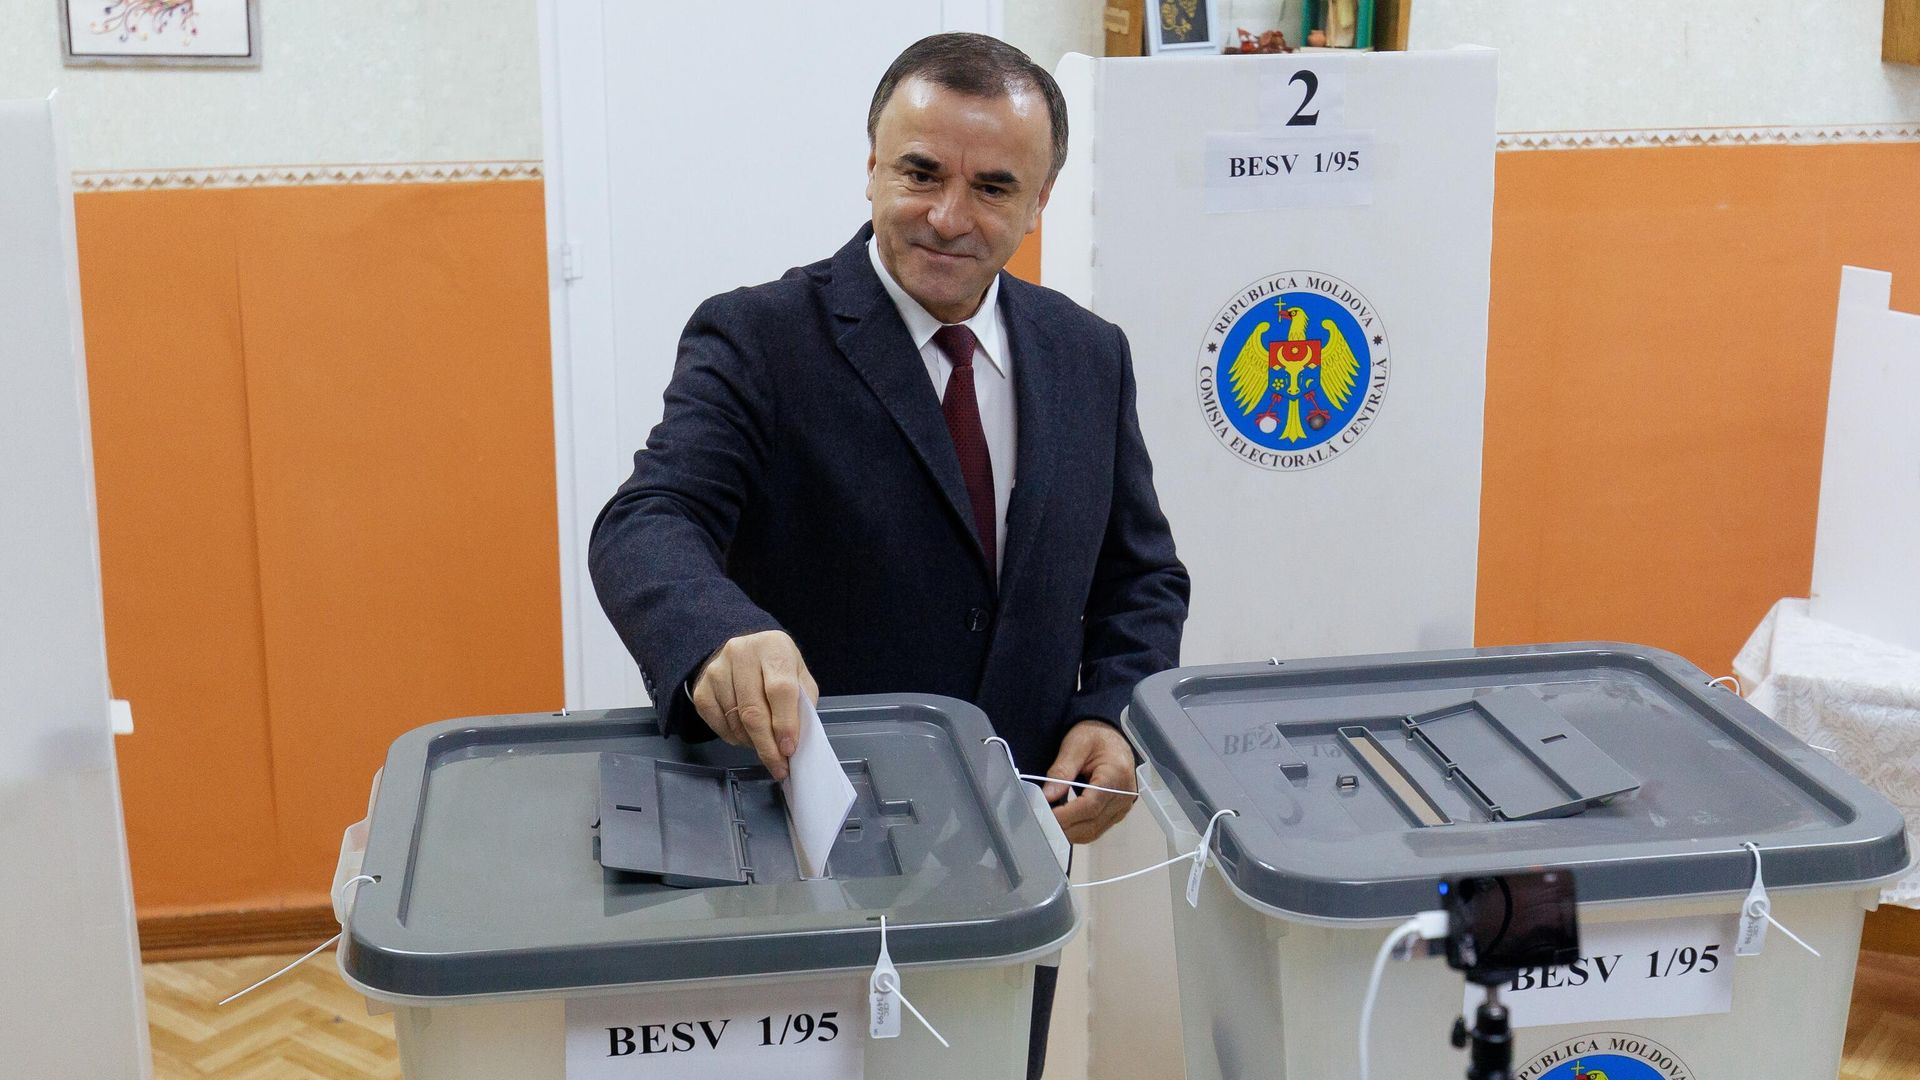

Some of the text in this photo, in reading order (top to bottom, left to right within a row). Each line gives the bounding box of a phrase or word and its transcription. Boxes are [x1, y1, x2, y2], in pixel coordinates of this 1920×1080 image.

[1285, 69, 1320, 126] 2
[1229, 151, 1360, 177] BESV 1/95
[1214, 276, 1374, 335] REPUBLICA MOLDOVA
[1200, 357, 1388, 468] COMISIA ELECTORALĂ CENTRALĂ
[1507, 944, 1720, 992] BESV 1/95
[604, 1011, 840, 1057] BESV 1/95
[1518, 1039, 1600, 1080] PUBLICA
